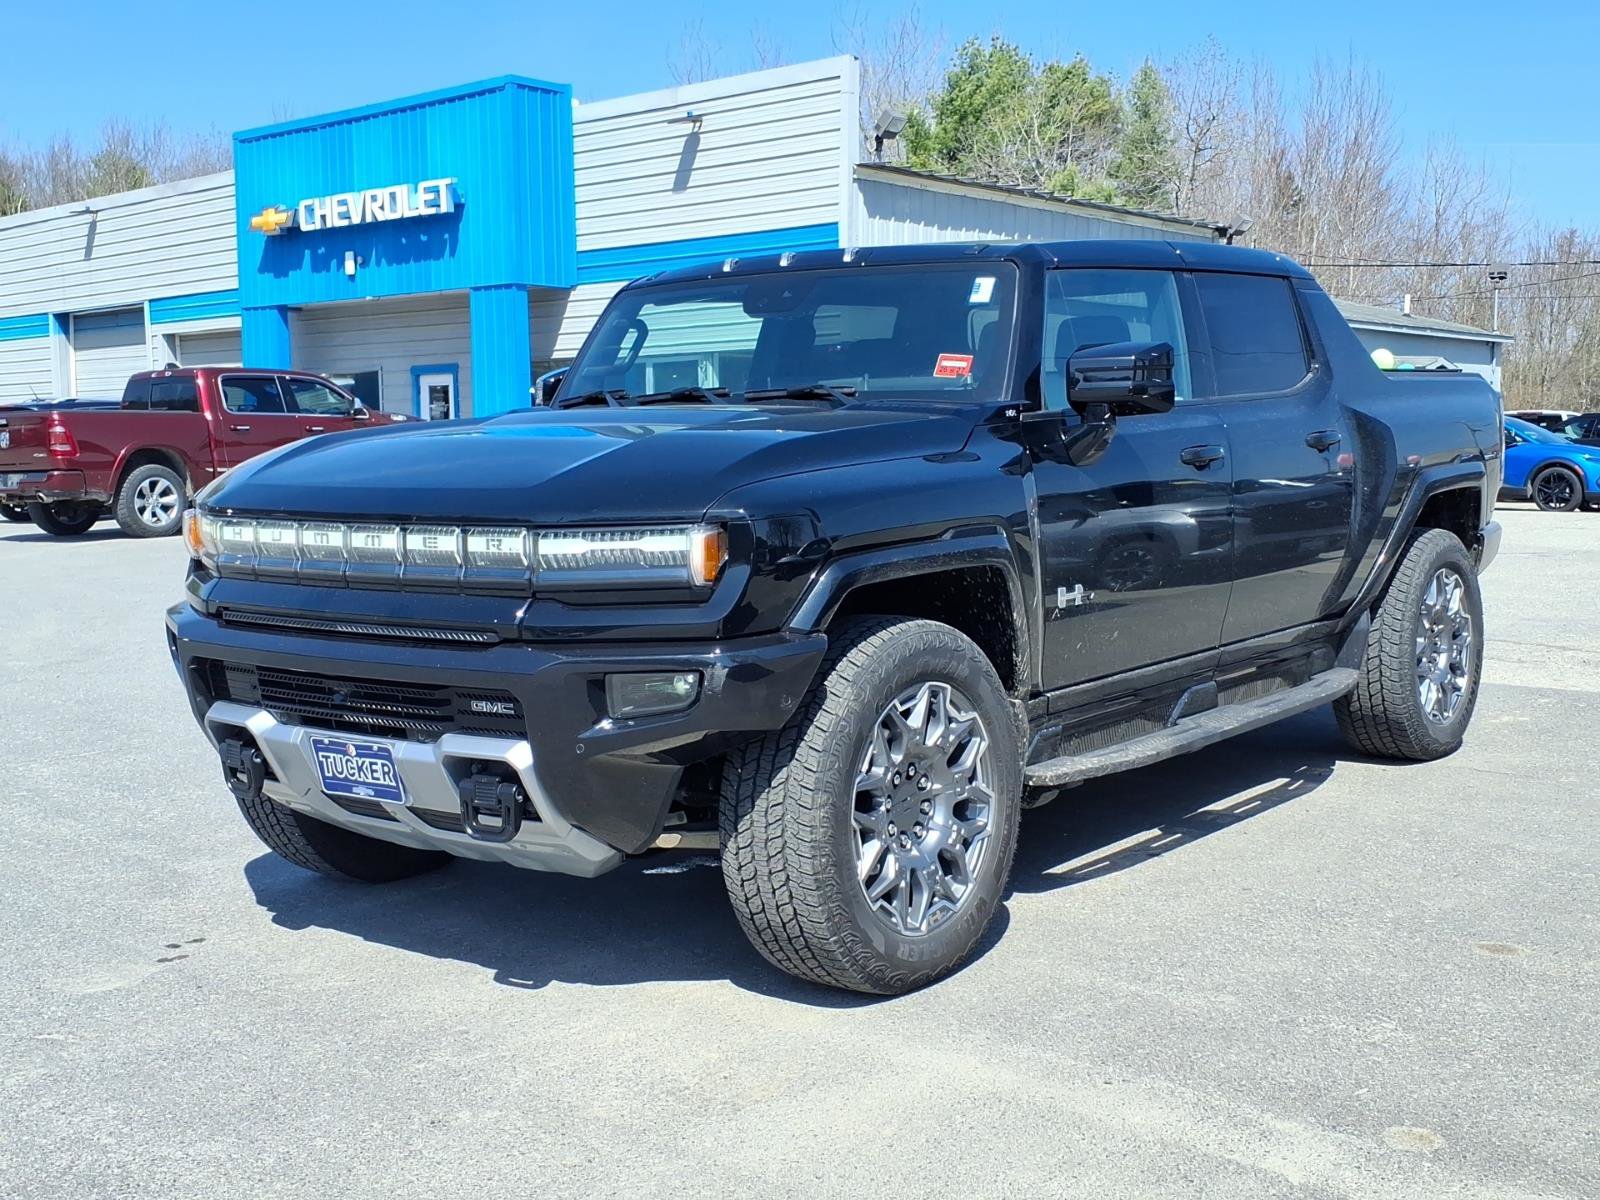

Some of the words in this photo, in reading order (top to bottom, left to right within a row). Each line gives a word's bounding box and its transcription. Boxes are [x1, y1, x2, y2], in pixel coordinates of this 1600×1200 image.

[299, 177, 456, 232] CHEVROLET
[232, 528, 503, 551] HUMMER
[471, 700, 514, 714] GMC
[318, 751, 397, 787] TUCKER
